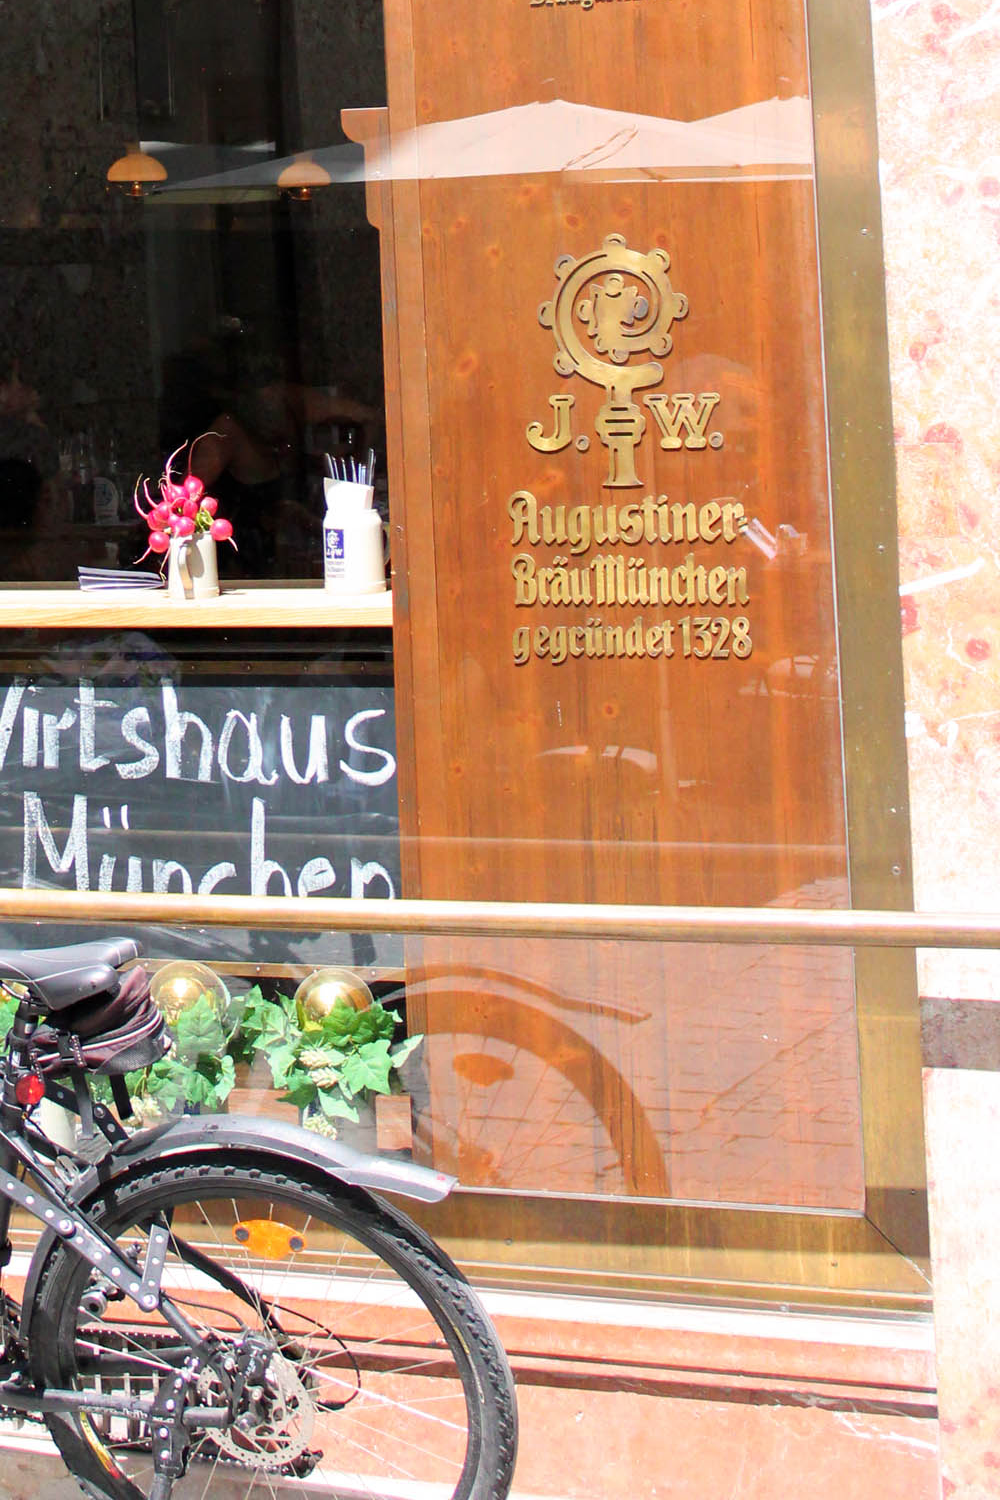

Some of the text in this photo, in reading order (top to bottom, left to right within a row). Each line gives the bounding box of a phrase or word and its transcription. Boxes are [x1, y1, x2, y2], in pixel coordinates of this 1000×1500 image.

[511, 614, 754, 667] gegründet 1328
[22, 790, 396, 900] München
